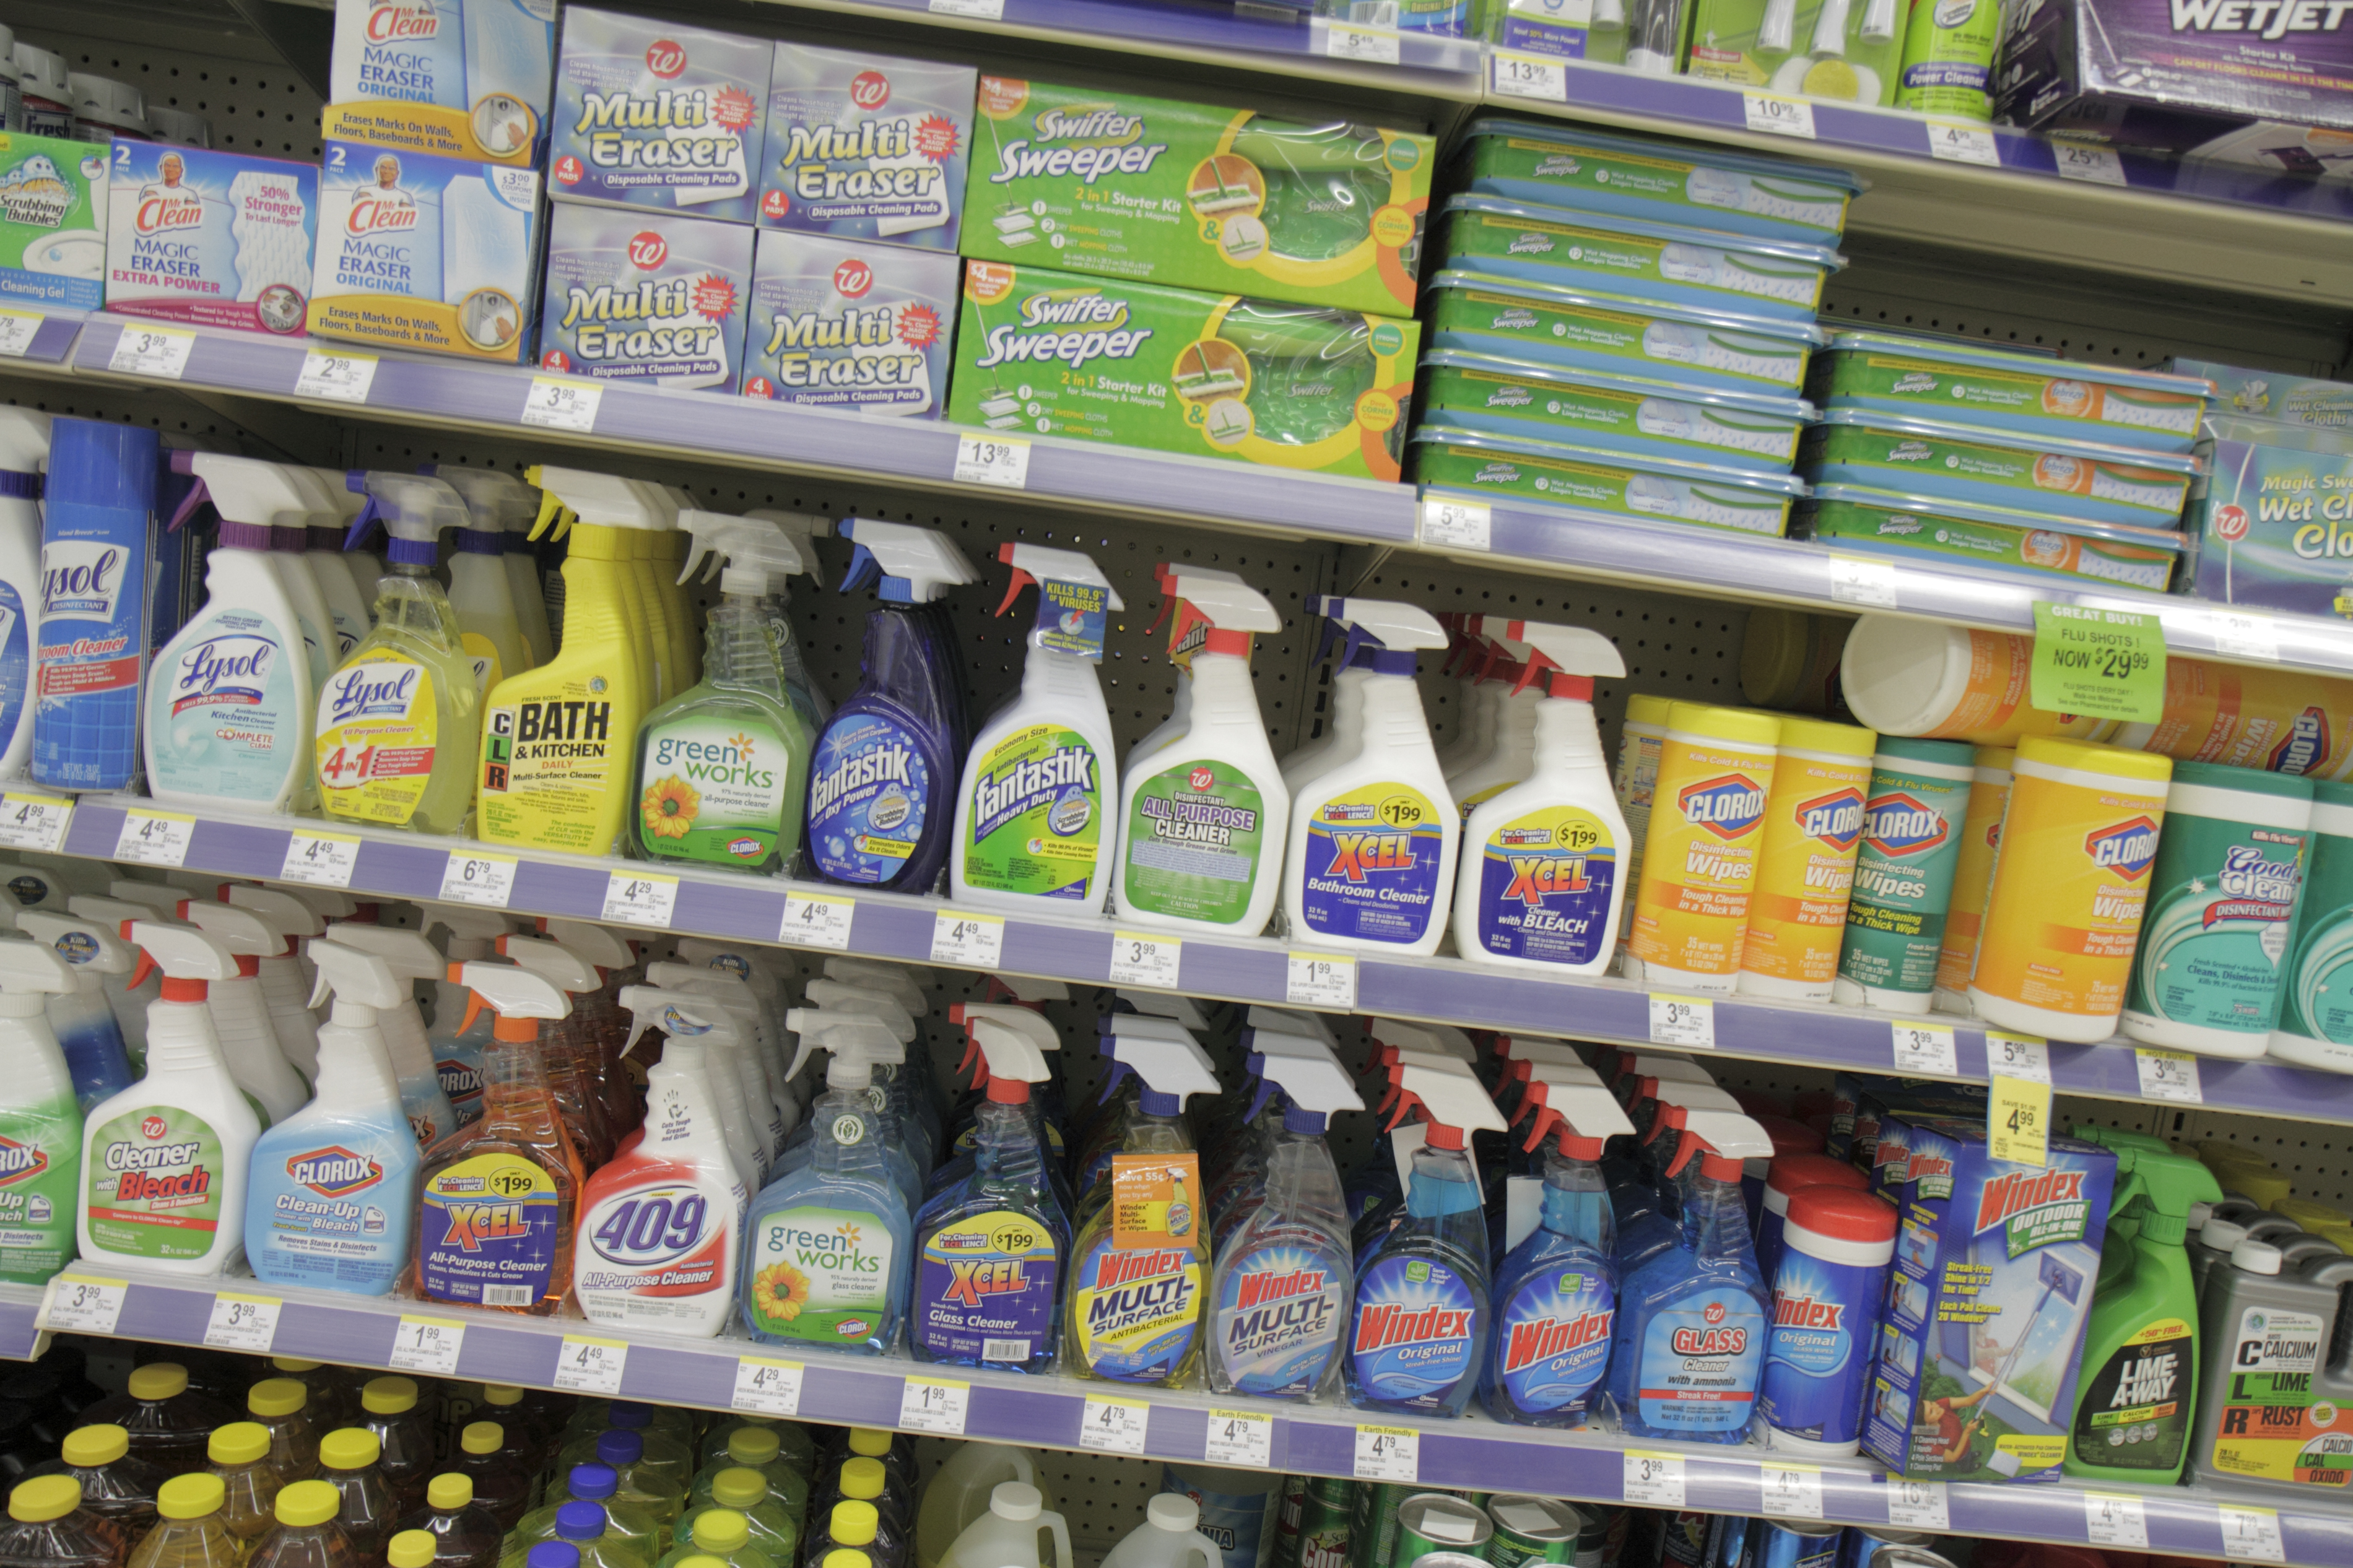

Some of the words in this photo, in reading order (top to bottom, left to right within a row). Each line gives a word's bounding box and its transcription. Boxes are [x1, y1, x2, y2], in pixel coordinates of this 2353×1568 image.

[368, 7, 437, 40] Clean
[2171, 0, 2348, 40] WETJET
[365, 48, 433, 73] MAGIC
[2238, 45, 2276, 60] Starter
[2279, 51, 2296, 63] Kit
[360, 65, 434, 92] ERASER
[358, 82, 437, 104] ORIGINAL
[576, 90, 707, 131] Multi
[334, 124, 365, 138] Floors,
[370, 129, 424, 145] Baseboards
[427, 139, 433, 147] &
[437, 141, 463, 151] More
[343, 113, 373, 126] Erases
[376, 117, 404, 129] Marks
[409, 122, 422, 133] On
[425, 124, 455, 139] Walls,
[591, 132, 738, 167] Eraser
[607, 173, 662, 186] Disposable
[665, 173, 707, 186] Cleaning
[710, 173, 737, 186] Pads
[0, 193, 64, 217] Scrubbing
[260, 186, 290, 201] 50%
[7, 208, 60, 228] Bubbles
[245, 196, 303, 217] Stronger
[1, 279, 45, 298] Cleaning
[47, 284, 64, 298] Gel
[112, 269, 160, 287] EXTRA
[164, 275, 220, 295] POWER
[1022, 297, 1127, 327] Swiffer
[977, 327, 1152, 368] Sweeper
[1061, 373, 1070, 384] 2
[1072, 375, 1084, 385] in
[1087, 376, 1095, 386] 1
[1098, 377, 1143, 395] Starter
[1147, 384, 1167, 397] Kit
[2259, 495, 2314, 521] Wet
[1046, 583, 1074, 596] KILLS
[1077, 588, 1105, 601] 99.9%
[2052, 606, 2100, 622] GREAT
[2107, 613, 2142, 626] BUY!
[2062, 630, 2084, 642] FLU
[2089, 632, 2132, 646] SHOTS
[181, 645, 267, 692] Lysol
[2054, 651, 2090, 669] NOW
[334, 670, 414, 715] Lysol
[211, 711, 249, 723] Kitchen
[518, 702, 611, 743] BATH
[215, 728, 273, 744] COMPLETE
[343, 727, 352, 735] All
[354, 726, 384, 737] Purpose
[386, 726, 414, 735] Cleaner
[994, 733, 1029, 756] Economy
[1031, 727, 1048, 739] Size
[515, 746, 528, 758] &
[531, 743, 605, 758] KITCHEN
[656, 737, 738, 766] green
[996, 747, 1039, 773] Antibacterial
[513, 773, 567, 782] Multi-Surface
[570, 772, 602, 780] Cleaner
[542, 760, 574, 770] DAILY
[686, 761, 773, 789] works
[811, 744, 911, 820] fantastik
[976, 746, 1092, 826] fantastik
[705, 795, 742, 807] all-purpose
[744, 800, 770, 808] cleaner
[825, 802, 842, 819] Oxy
[844, 784, 879, 806] Power
[998, 802, 1030, 826] Heavy
[1031, 789, 1058, 810] Duty
[1175, 792, 1225, 807] DISINFECTANT
[1687, 790, 1766, 823] CLOROX
[1142, 796, 1173, 819] ALL
[1176, 802, 1255, 829] PURPOSE
[1155, 820, 1230, 846] CLEANER
[1325, 831, 1416, 883] XCEL
[1690, 841, 1753, 859] Disinfecting
[1685, 854, 1753, 881] Wipes
[1308, 878, 1375, 898] Bathroom
[1379, 888, 1429, 904] Cleaner
[1682, 889, 1713, 905] Tough
[1716, 894, 1748, 907] Cleaning
[1679, 901, 1689, 909] in
[1702, 903, 1727, 914] Thick
[1729, 907, 1746, 917] Wipe
[2217, 905, 2279, 918] DISINFECTANT
[1498, 916, 1521, 927] with
[1524, 916, 1588, 934] BLEACH
[2002, 1100, 2019, 1108] SAVE
[2020, 1103, 2037, 1112] $1.00
[106, 1141, 199, 1171] Cleaner
[294, 1156, 373, 1185] CLOROX
[97, 1178, 117, 1192] with
[117, 1166, 210, 1201] Bleach
[276, 1195, 360, 1218] Clean-Up
[1977, 1170, 2087, 1232] Windex
[596, 1197, 705, 1251] 409
[2012, 1203, 2084, 1231] OUTDOOR
[2029, 1220, 2083, 1236] ALL-IN-ONE
[310, 1239, 331, 1247] Stains
[340, 1242, 378, 1252] Disinfects
[582, 1272, 659, 1288] All-Purpose
[662, 1268, 713, 1285] Cleaner
[1097, 1250, 1184, 1289] Windex
[1090, 1276, 1194, 1322] MULTI-
[930, 1309, 964, 1326] Glass
[967, 1314, 1018, 1330] Cleaner
[1092, 1299, 1187, 1337] SURFACE
[1110, 1314, 1185, 1340] ANTIBACTERIAL
[1356, 1305, 1472, 1353] Windex
[1256, 1340, 1303, 1358] VINEGAR
[1398, 1342, 1462, 1361] Original
[1675, 1328, 1746, 1354] GLASS
[2263, 1341, 2317, 1360] CALCIUM
[1683, 1359, 1729, 1373] Cleaner
[1668, 1375, 1690, 1386] with
[1693, 1377, 1736, 1387] ammonia
[2273, 1372, 2310, 1391] LIME
[1677, 1391, 1701, 1400] Streak
[1703, 1392, 1721, 1401] Free!
[1216, 1410, 1235, 1418] Earth
[1237, 1411, 1265, 1421] Friendly
[2261, 1407, 2307, 1426] RUST
[2305, 1453, 2326, 1467] CAL
